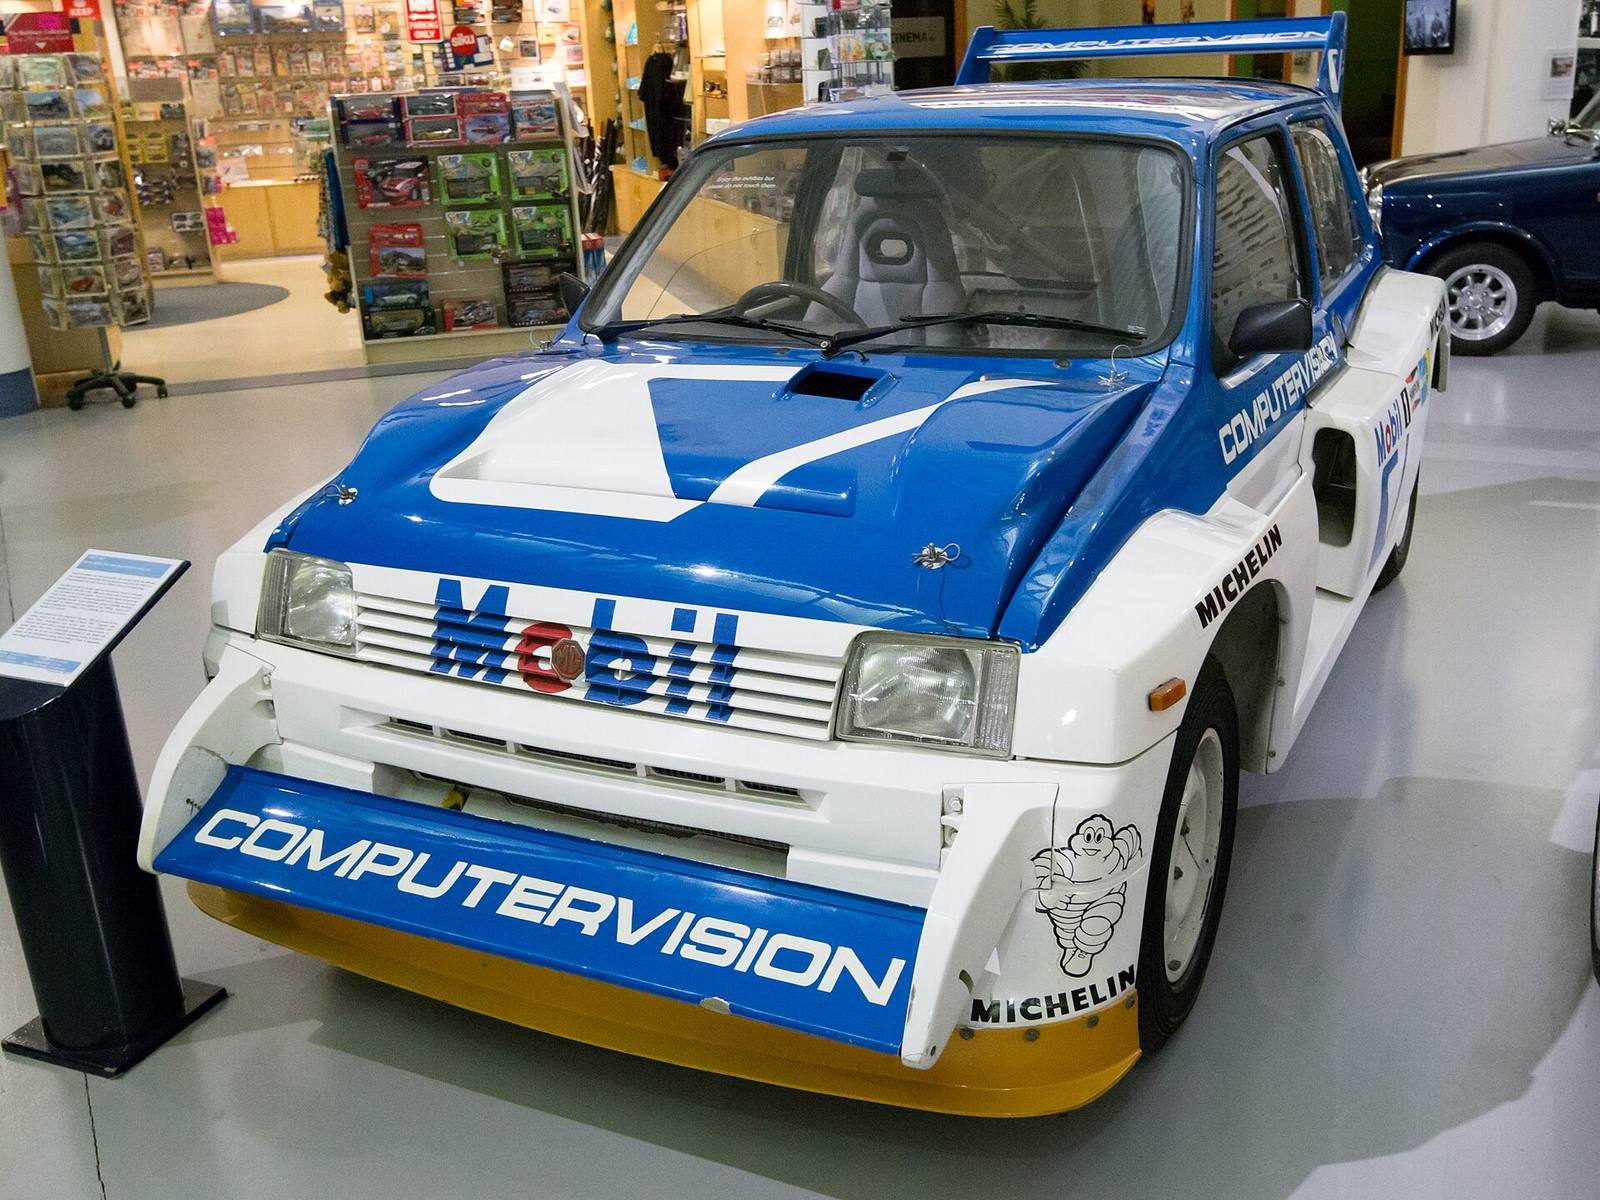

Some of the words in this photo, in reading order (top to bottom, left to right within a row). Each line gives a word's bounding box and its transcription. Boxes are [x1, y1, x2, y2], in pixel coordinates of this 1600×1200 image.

[409, 20, 438, 30] PARKING
[414, 30, 435, 39] ONLY
[987, 31, 1329, 55] COMPUTERVISION
[1374, 399, 1403, 467] Mobil
[1195, 523, 1282, 629] MICHELIN
[429, 577, 740, 723] Mobil
[194, 808, 907, 1007] COMPUTERVISION
[970, 964, 1136, 1024] MICHELIN
